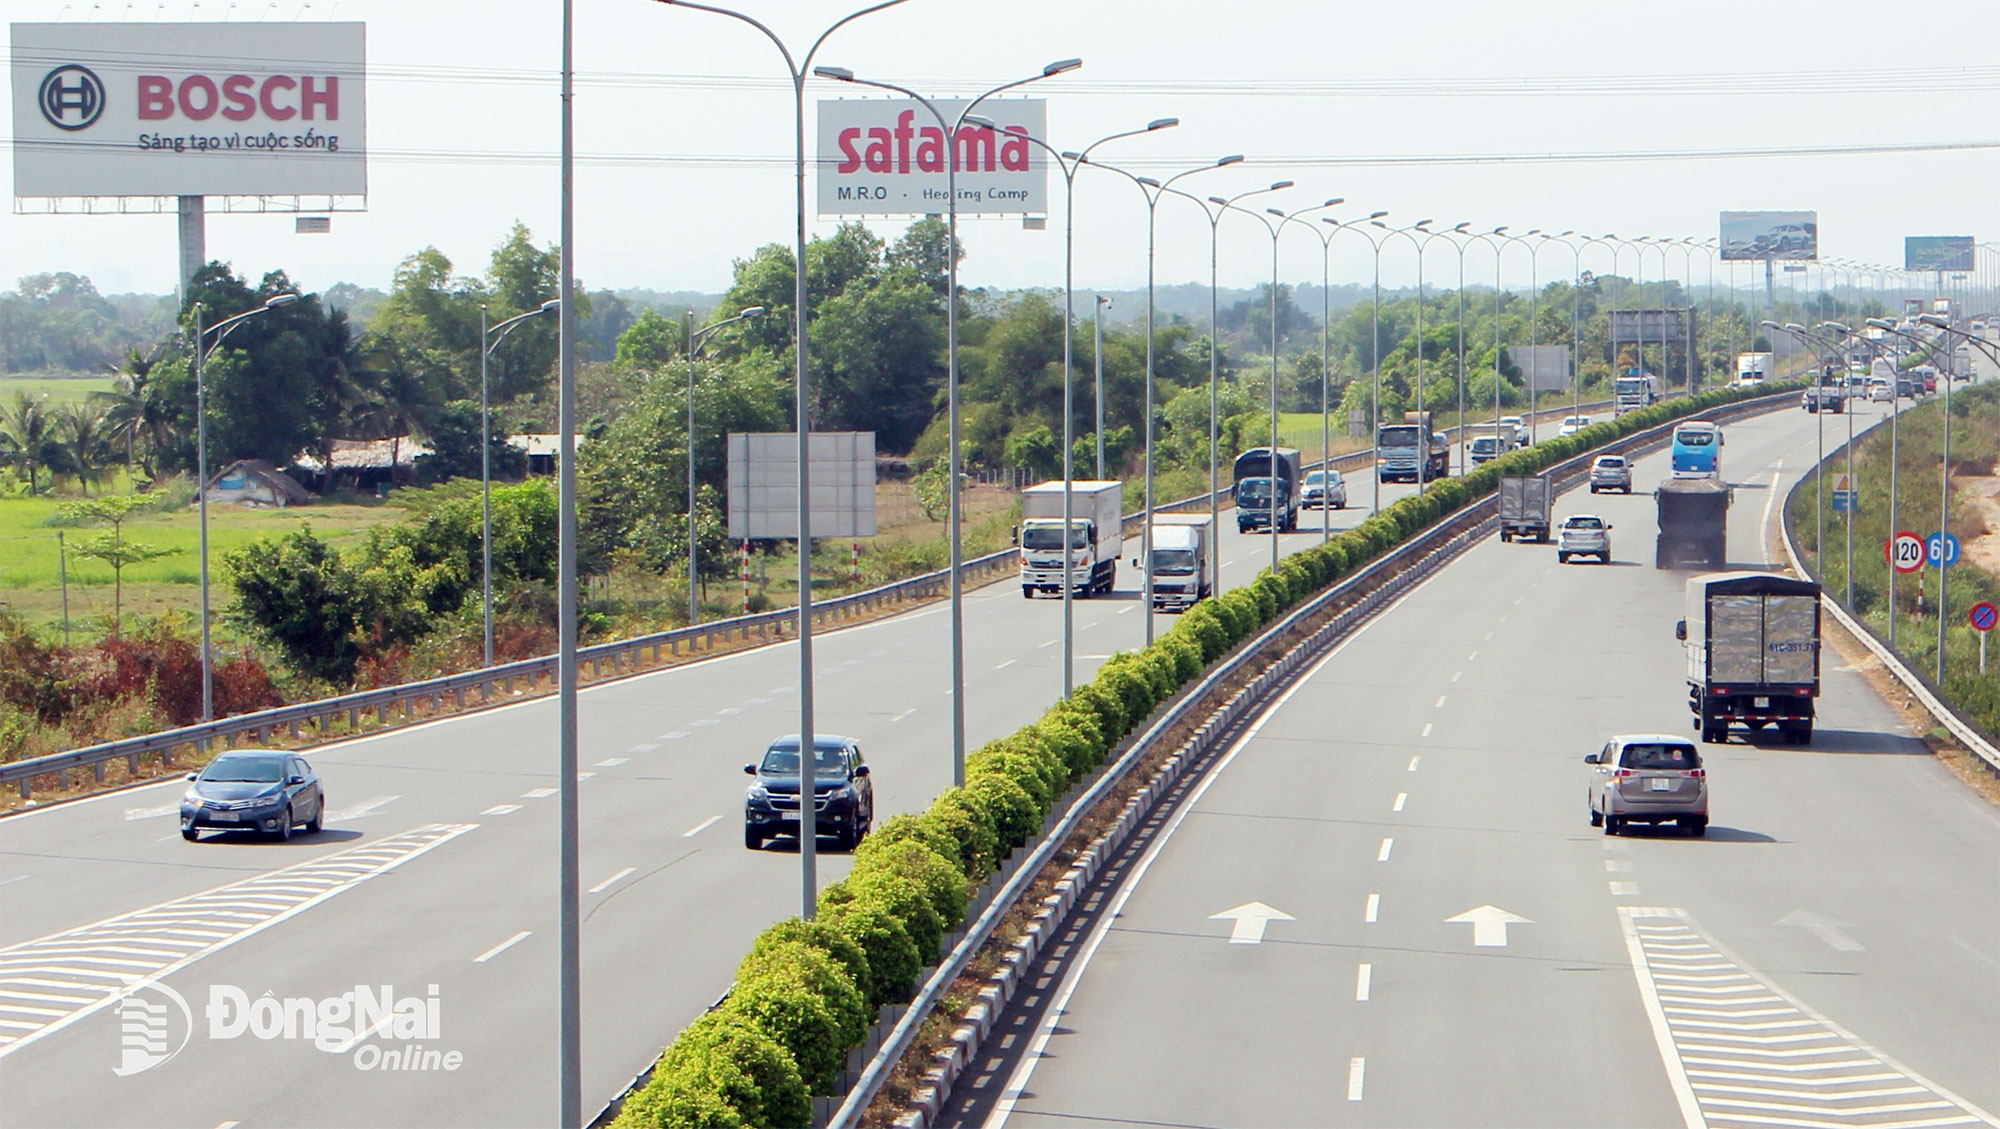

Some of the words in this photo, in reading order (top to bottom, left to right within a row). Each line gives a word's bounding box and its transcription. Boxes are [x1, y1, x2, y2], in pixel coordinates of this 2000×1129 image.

[138, 75, 339, 121] BOSCH
[139, 132, 185, 152] Sáng
[191, 134, 220, 151] tạo
[224, 132, 240, 148] vì
[245, 132, 289, 151] cuộc
[294, 127, 339, 152] sống
[838, 109, 1030, 174] safama
[838, 187, 888, 200] M.R.O
[988, 187, 1029, 202] Camp
[1896, 542, 1919, 561] 120
